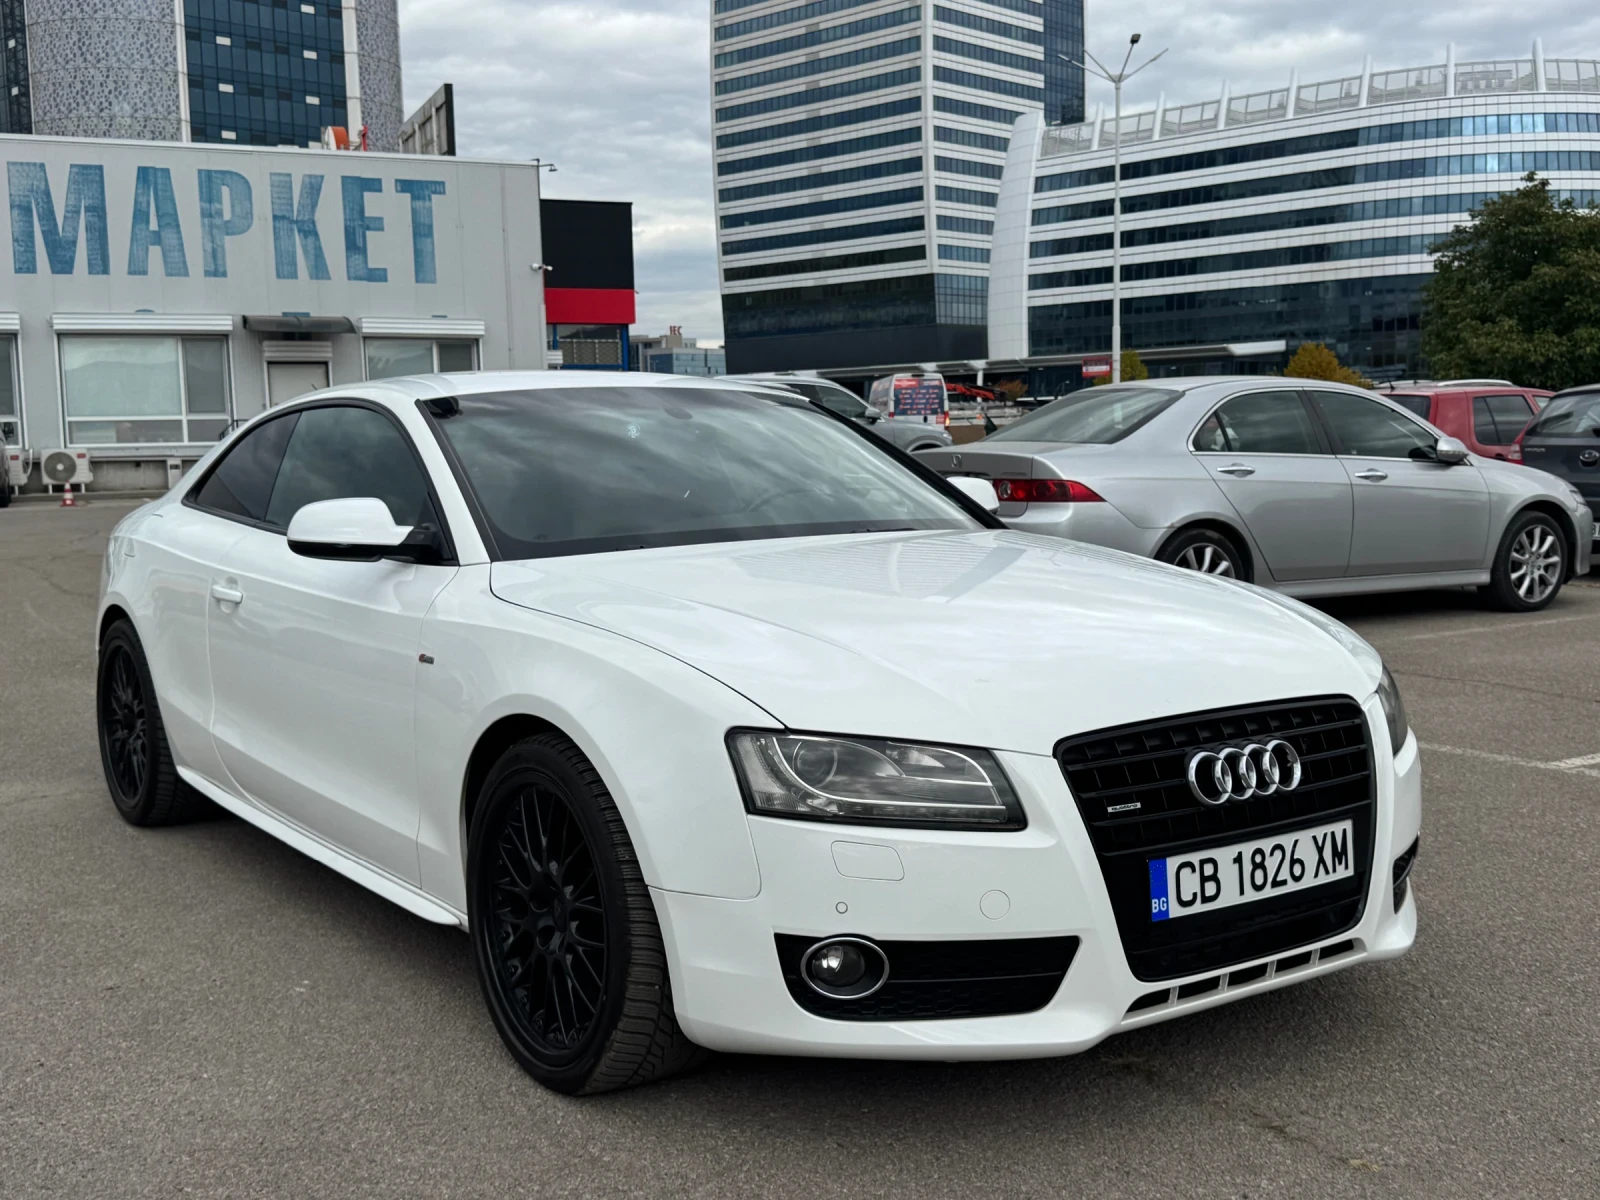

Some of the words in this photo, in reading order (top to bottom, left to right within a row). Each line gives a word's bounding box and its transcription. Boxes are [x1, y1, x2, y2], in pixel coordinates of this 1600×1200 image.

[7, 161, 447, 285] МАРКЕТ
[1151, 897, 1168, 914] BG
[1174, 857, 1222, 909] CB
[1232, 838, 1306, 897] 1826
[1311, 827, 1350, 880] XM
